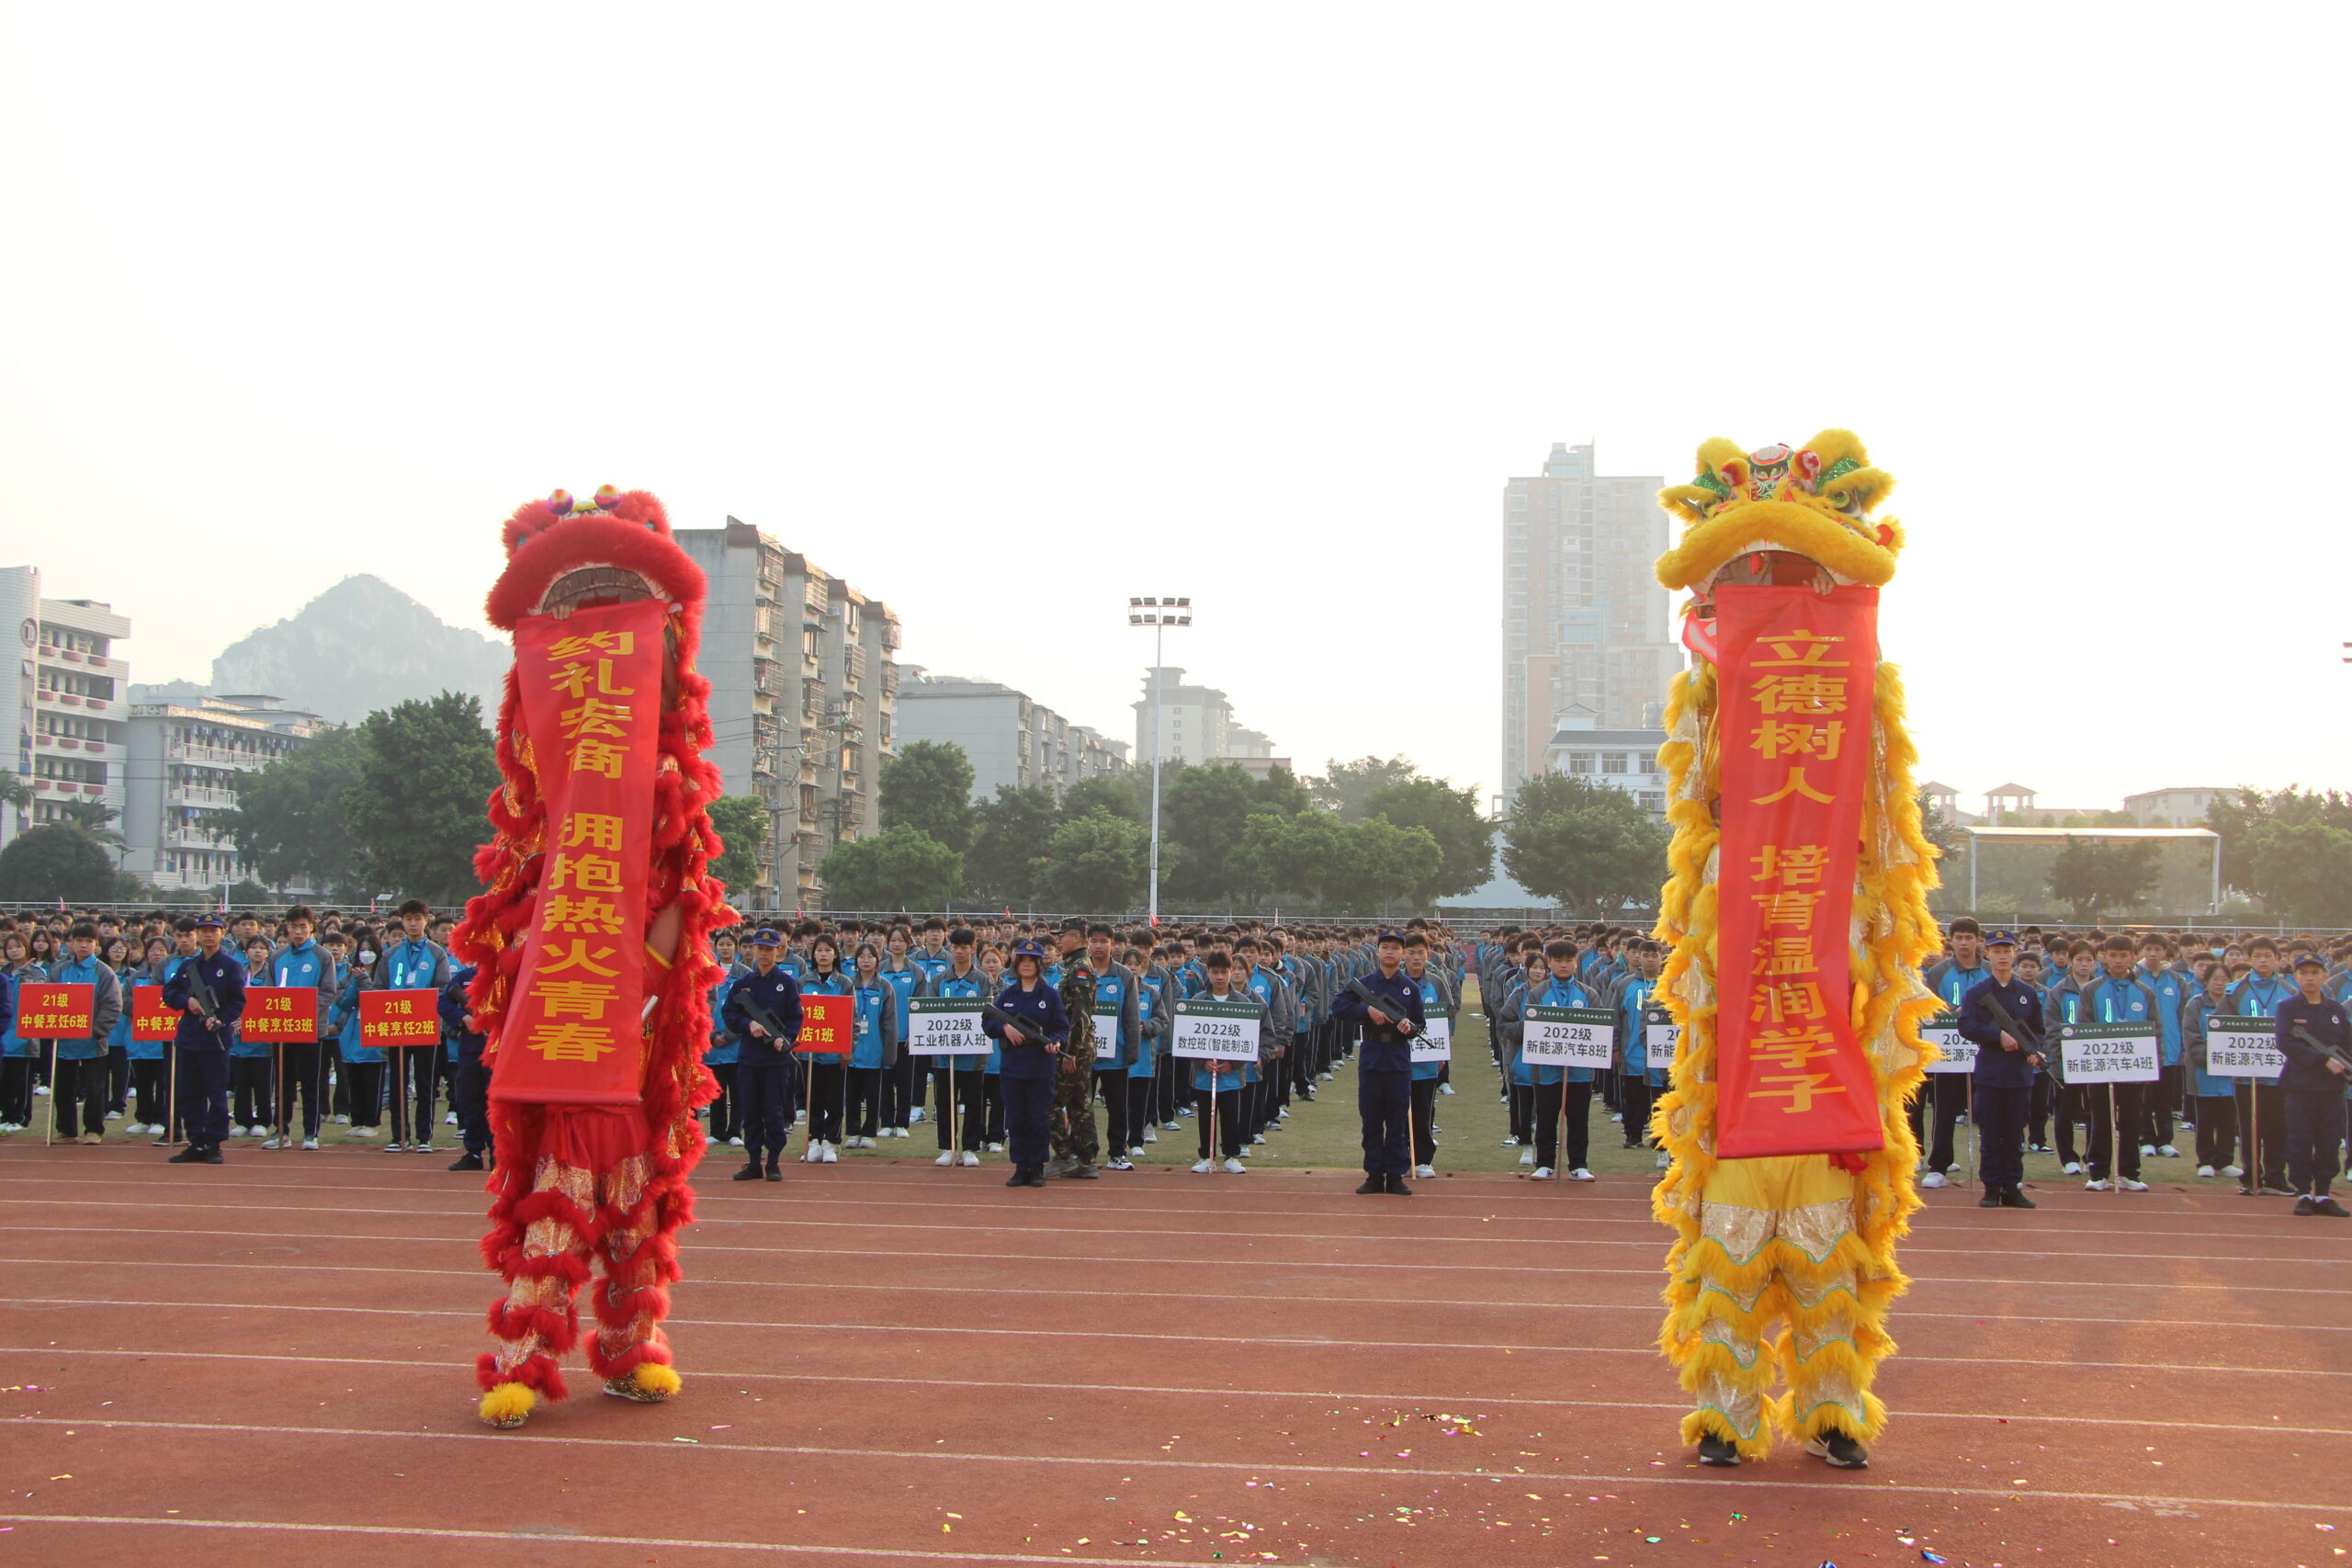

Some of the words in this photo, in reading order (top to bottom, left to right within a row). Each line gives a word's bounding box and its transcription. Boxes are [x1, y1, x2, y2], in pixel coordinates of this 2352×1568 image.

[547, 630, 636, 781] 约礼宏商
[1750, 629, 1850, 806] 立德树人
[526, 812, 625, 1063] 拥抱热火青春
[1748, 844, 1847, 1114] 培育温润学子
[42, 993, 69, 1008] 21级
[266, 997, 292, 1011] 21级
[385, 999, 413, 1015] 21级
[801, 1005, 825, 1021] 1级
[21, 1014, 88, 1030] 中餐烹饪6班
[137, 1016, 182, 1032] 中餐烹
[244, 1017, 314, 1033] 中餐烹饪3班
[364, 1020, 435, 1037] 中餐烹饪2班
[927, 1018, 973, 1032] 2022级
[1193, 1022, 1241, 1037] 2022级
[796, 1026, 834, 1043] 店1班
[913, 1032, 988, 1047] 工业机器人班
[1544, 1026, 1592, 1041] 2022级
[1526, 1040, 1608, 1058] 新能源汽车8班
[2082, 1041, 2135, 1055] 2022级
[2228, 1036, 2278, 1050] 2022级
[2066, 1056, 2154, 1073] 新能源汽车4班
